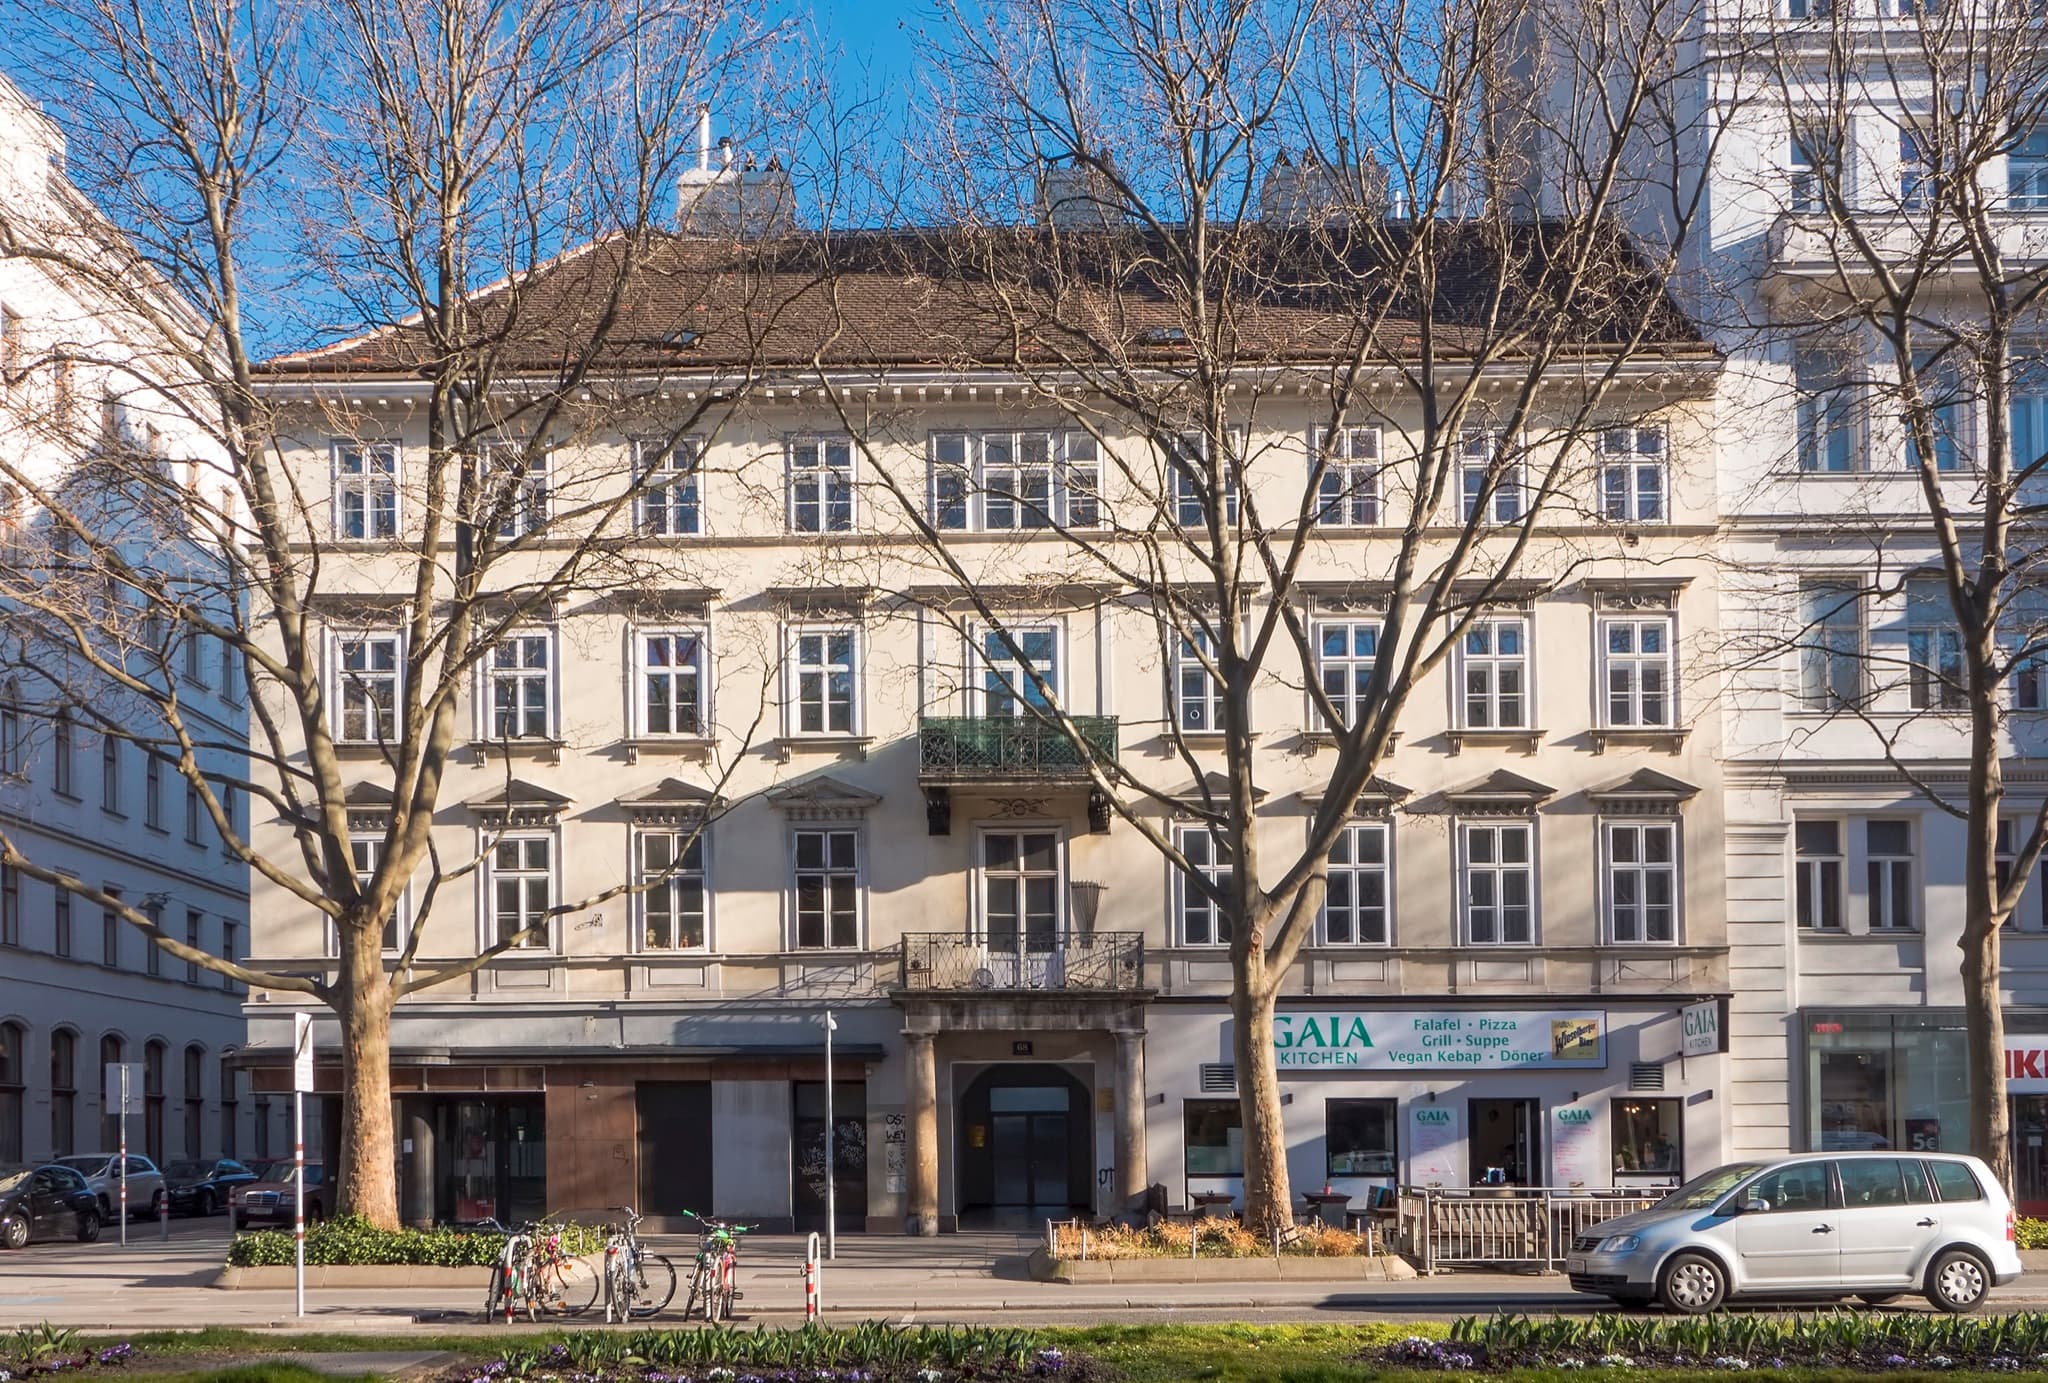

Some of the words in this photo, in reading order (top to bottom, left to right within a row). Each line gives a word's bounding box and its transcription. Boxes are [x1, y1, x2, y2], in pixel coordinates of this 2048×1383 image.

[1414, 1019, 1461, 1031] Falafel
[1479, 1019, 1517, 1031] Pizza
[1684, 1008, 1716, 1036] GAIA
[1273, 1016, 1374, 1048] GAIA
[1422, 1034, 1452, 1047] Grill
[1465, 1034, 1510, 1049] Suppe
[1280, 1052, 1358, 1064] KITCHEN
[1388, 1050, 1433, 1064] Vegan
[1437, 1050, 1482, 1064] Kebap
[1500, 1050, 1544, 1062] Döner
[1416, 1110, 1450, 1122] GAIA
[1558, 1109, 1592, 1121] GAIA
